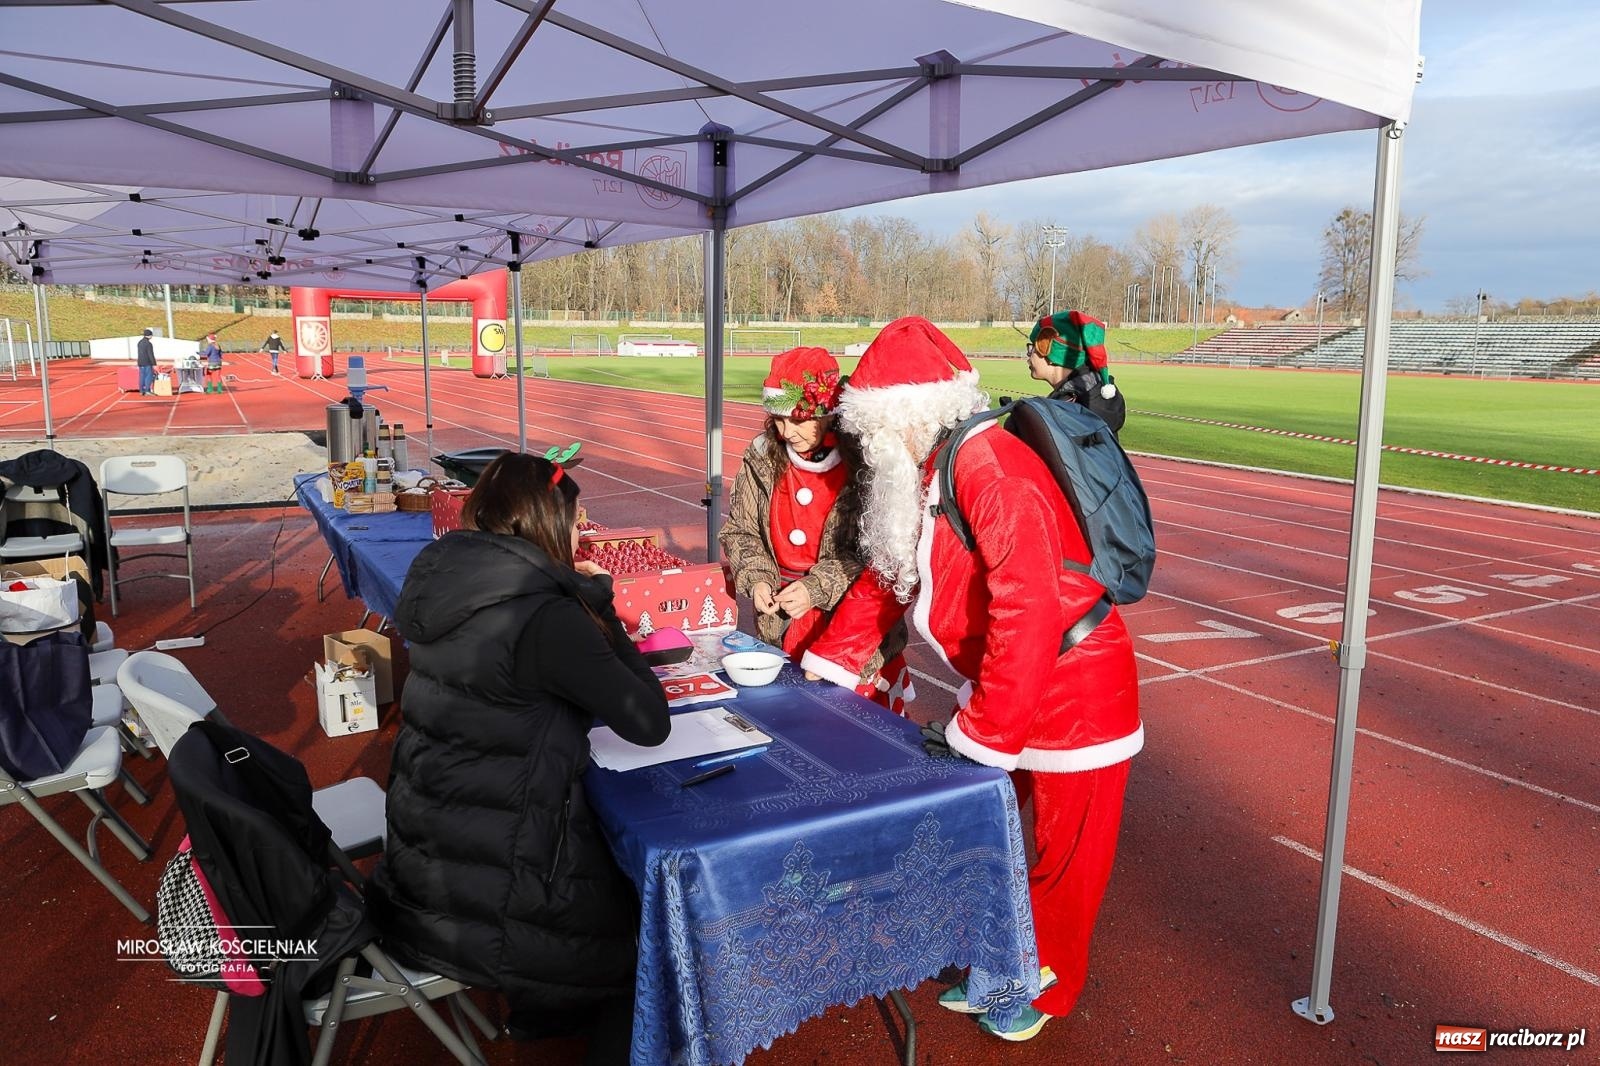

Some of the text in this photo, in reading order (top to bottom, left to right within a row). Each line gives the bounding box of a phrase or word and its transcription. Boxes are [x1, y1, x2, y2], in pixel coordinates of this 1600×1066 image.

[1393, 584, 1489, 604] 5
[1276, 602, 1377, 624] 6
[1137, 619, 1263, 643] 7
[666, 683, 694, 693] 67
